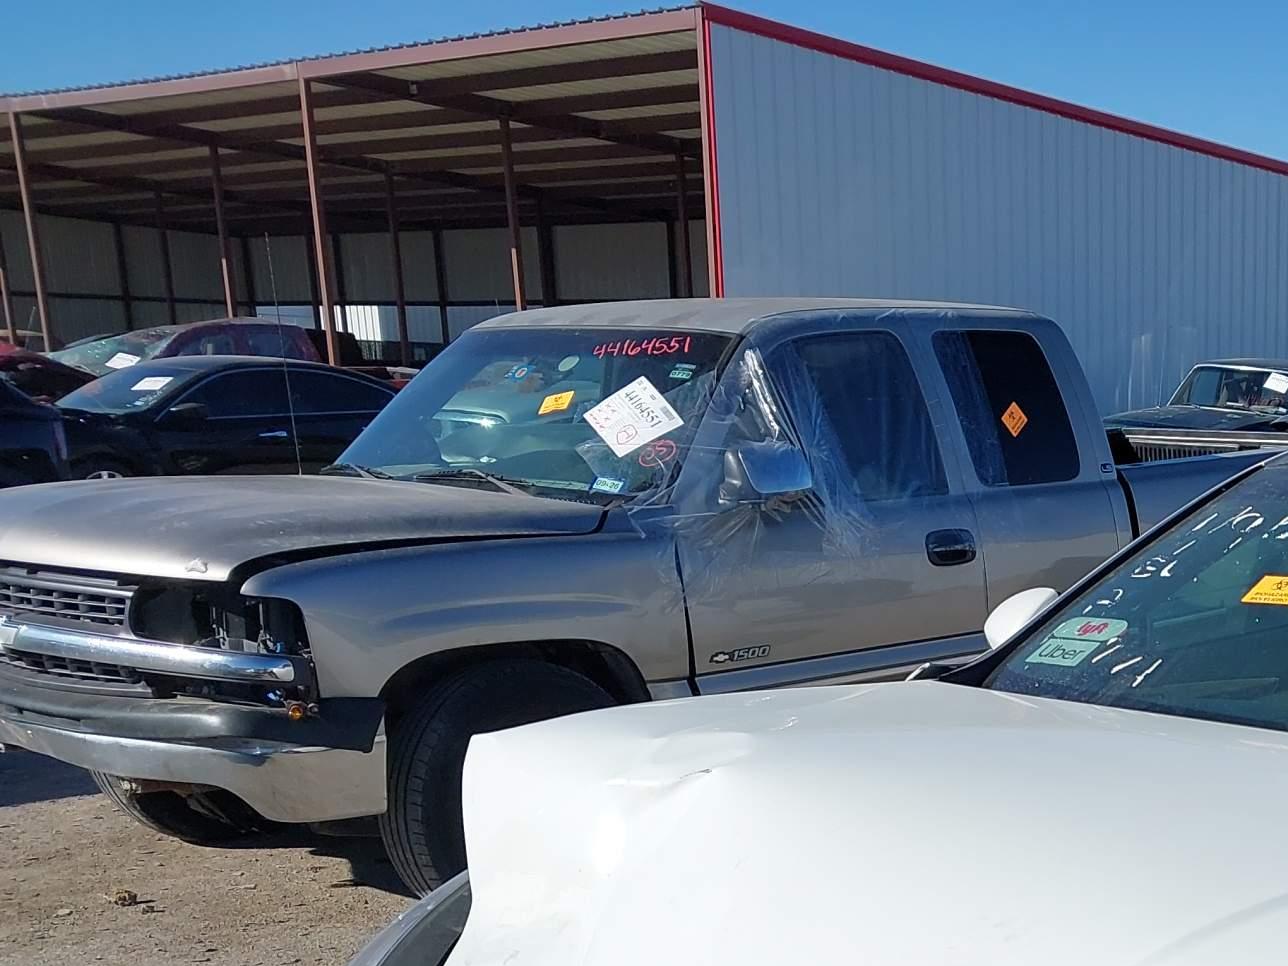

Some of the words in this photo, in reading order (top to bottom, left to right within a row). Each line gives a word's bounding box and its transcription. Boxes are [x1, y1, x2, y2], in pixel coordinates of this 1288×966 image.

[593, 336, 691, 359] 44164551
[624, 389, 663, 429] 44164551
[732, 646, 770, 661] 1500
[1038, 643, 1087, 660] Uber
